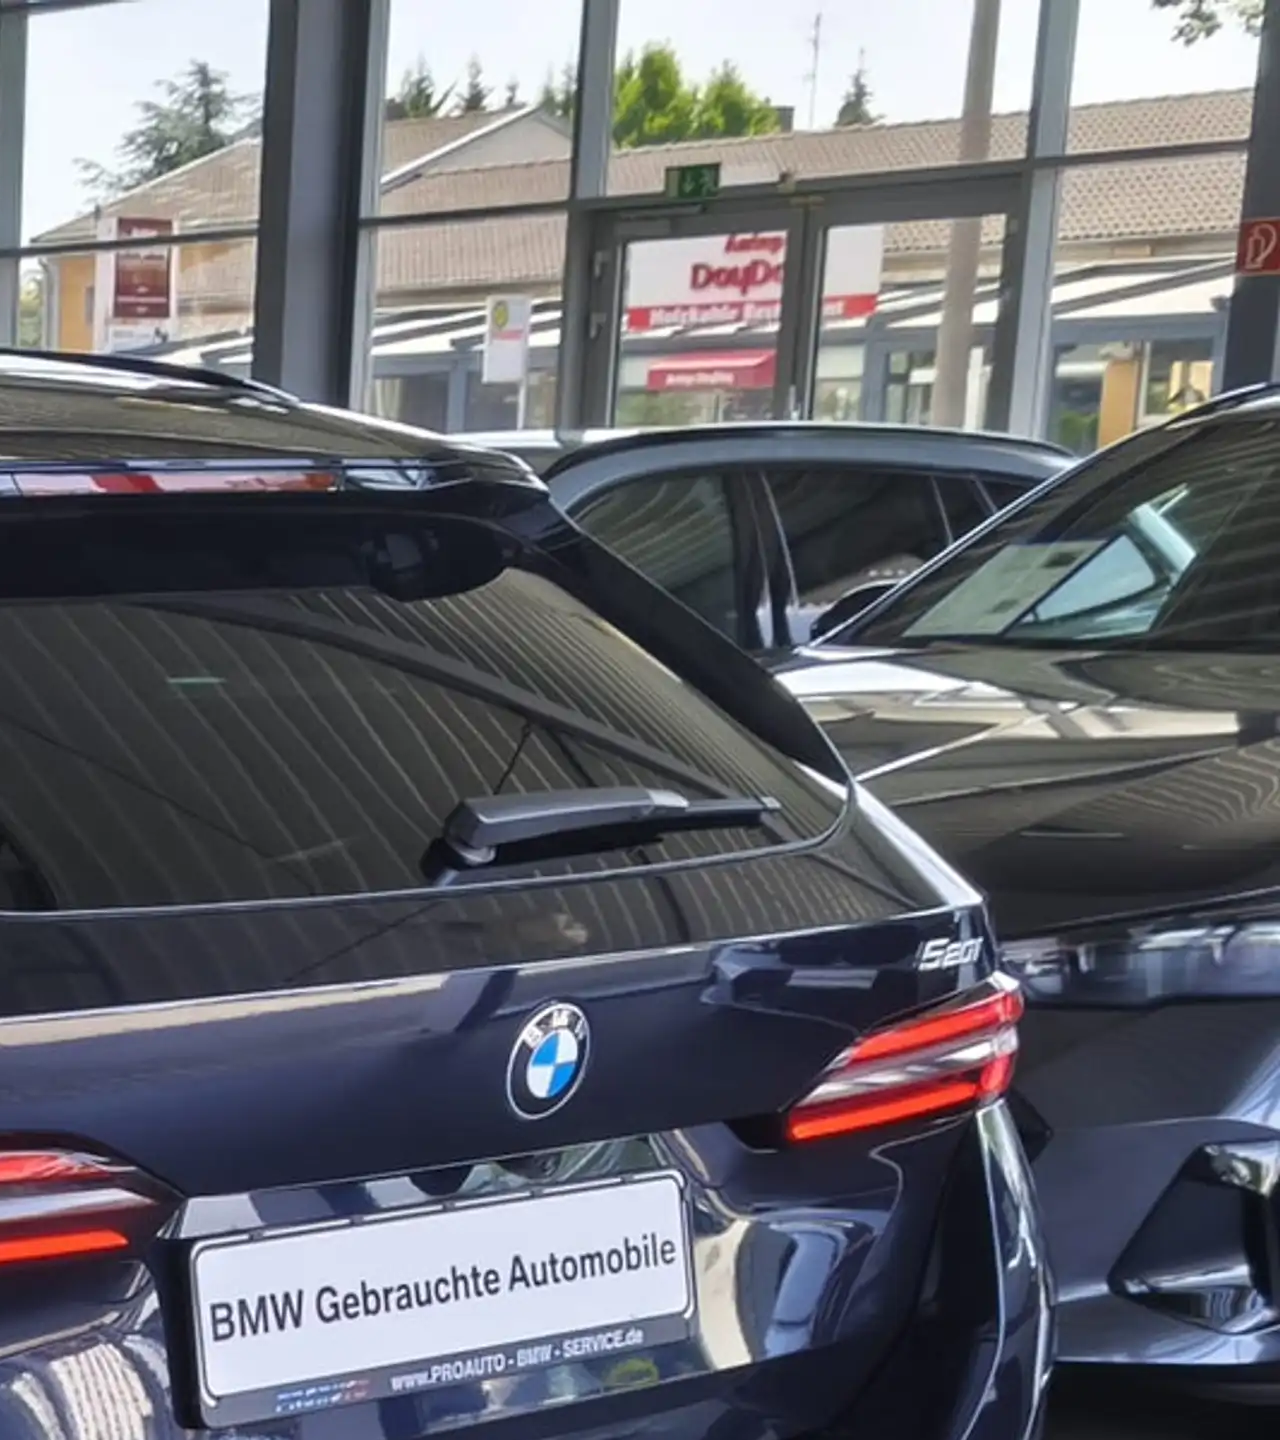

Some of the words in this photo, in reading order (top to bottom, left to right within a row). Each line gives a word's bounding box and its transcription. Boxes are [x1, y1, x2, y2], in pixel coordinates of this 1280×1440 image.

[690, 259, 784, 295] DoyDo
[209, 1287, 305, 1343] BMW
[315, 1262, 501, 1325] Gebrauchte
[507, 1232, 677, 1294] Automobile
